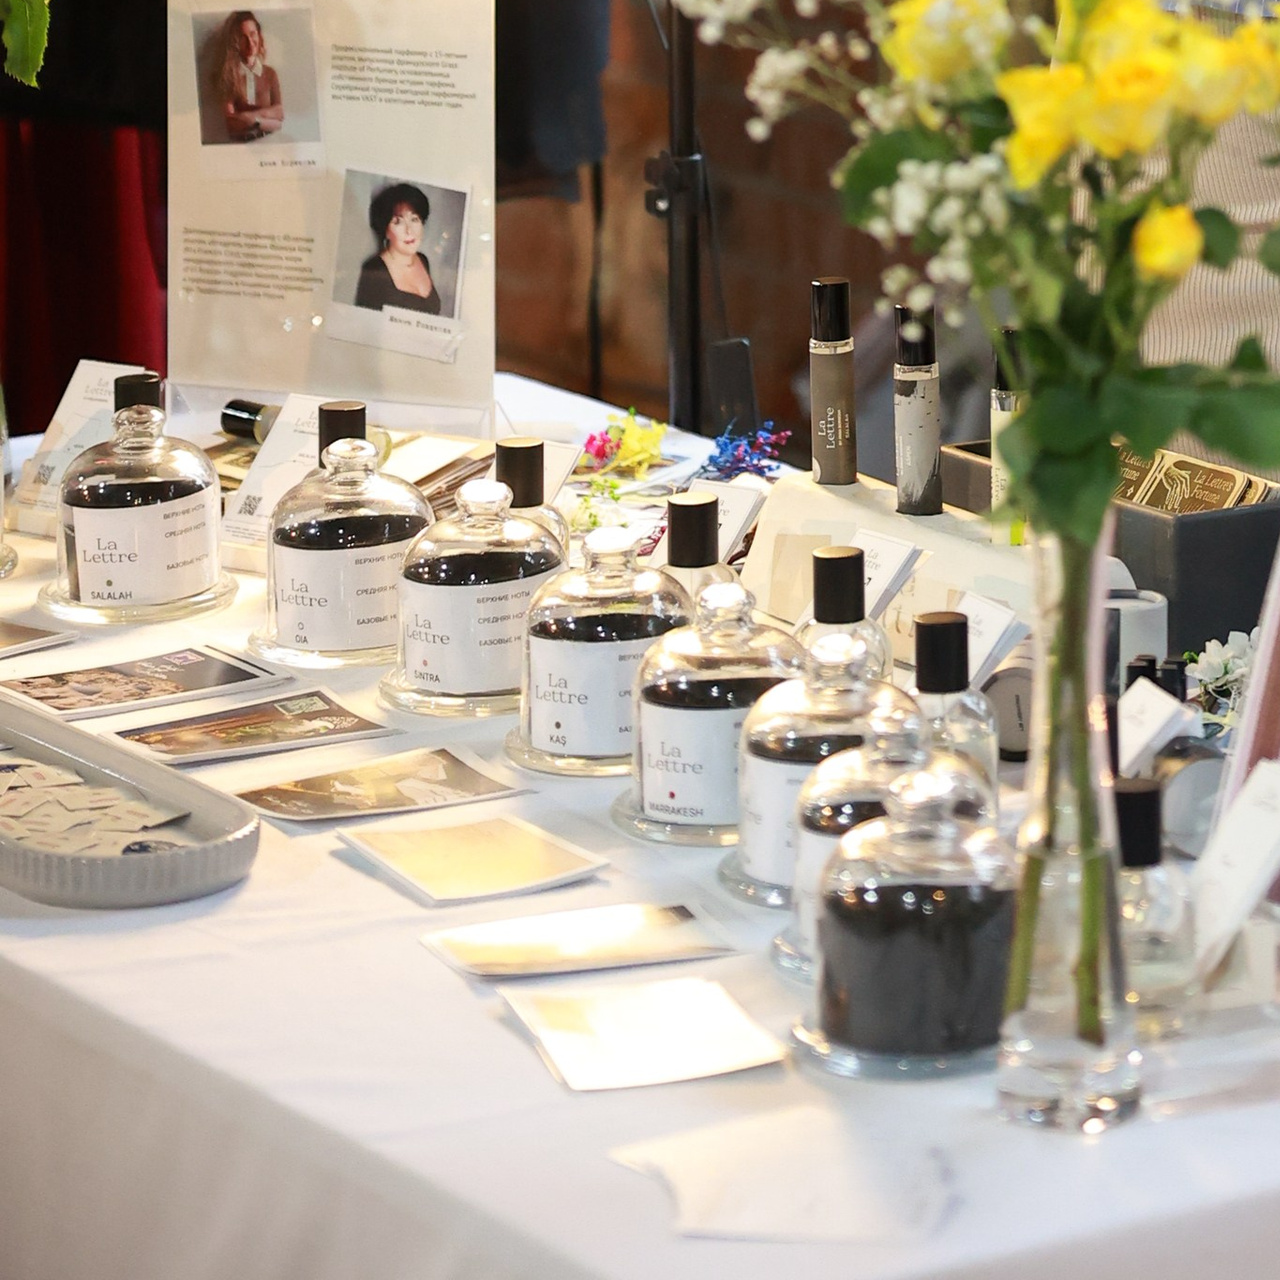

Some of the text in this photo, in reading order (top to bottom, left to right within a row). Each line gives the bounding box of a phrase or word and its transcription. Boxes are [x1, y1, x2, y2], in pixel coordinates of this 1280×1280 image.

[818, 420, 826, 436] La
[826, 407, 835, 449] Lettre
[1194, 470, 1205, 485] La
[1190, 485, 1221, 504] Fortune
[96, 538, 117, 550] La
[83, 550, 138, 564] Lettre
[355, 555, 386, 565] ВЕРХНИЕ
[291, 578, 308, 593] La
[90, 591, 132, 600] SALALAH
[281, 589, 328, 607] Lettre
[476, 593, 509, 604] ВЕРХНИЕ
[415, 614, 431, 629] La
[406, 624, 450, 645] Lettre
[414, 670, 440, 683] SINTRA
[548, 673, 568, 689] La
[535, 685, 588, 705] Lettre
[661, 741, 681, 758] La
[647, 753, 703, 774] Lettre
[649, 801, 704, 818] MARRAKESH
